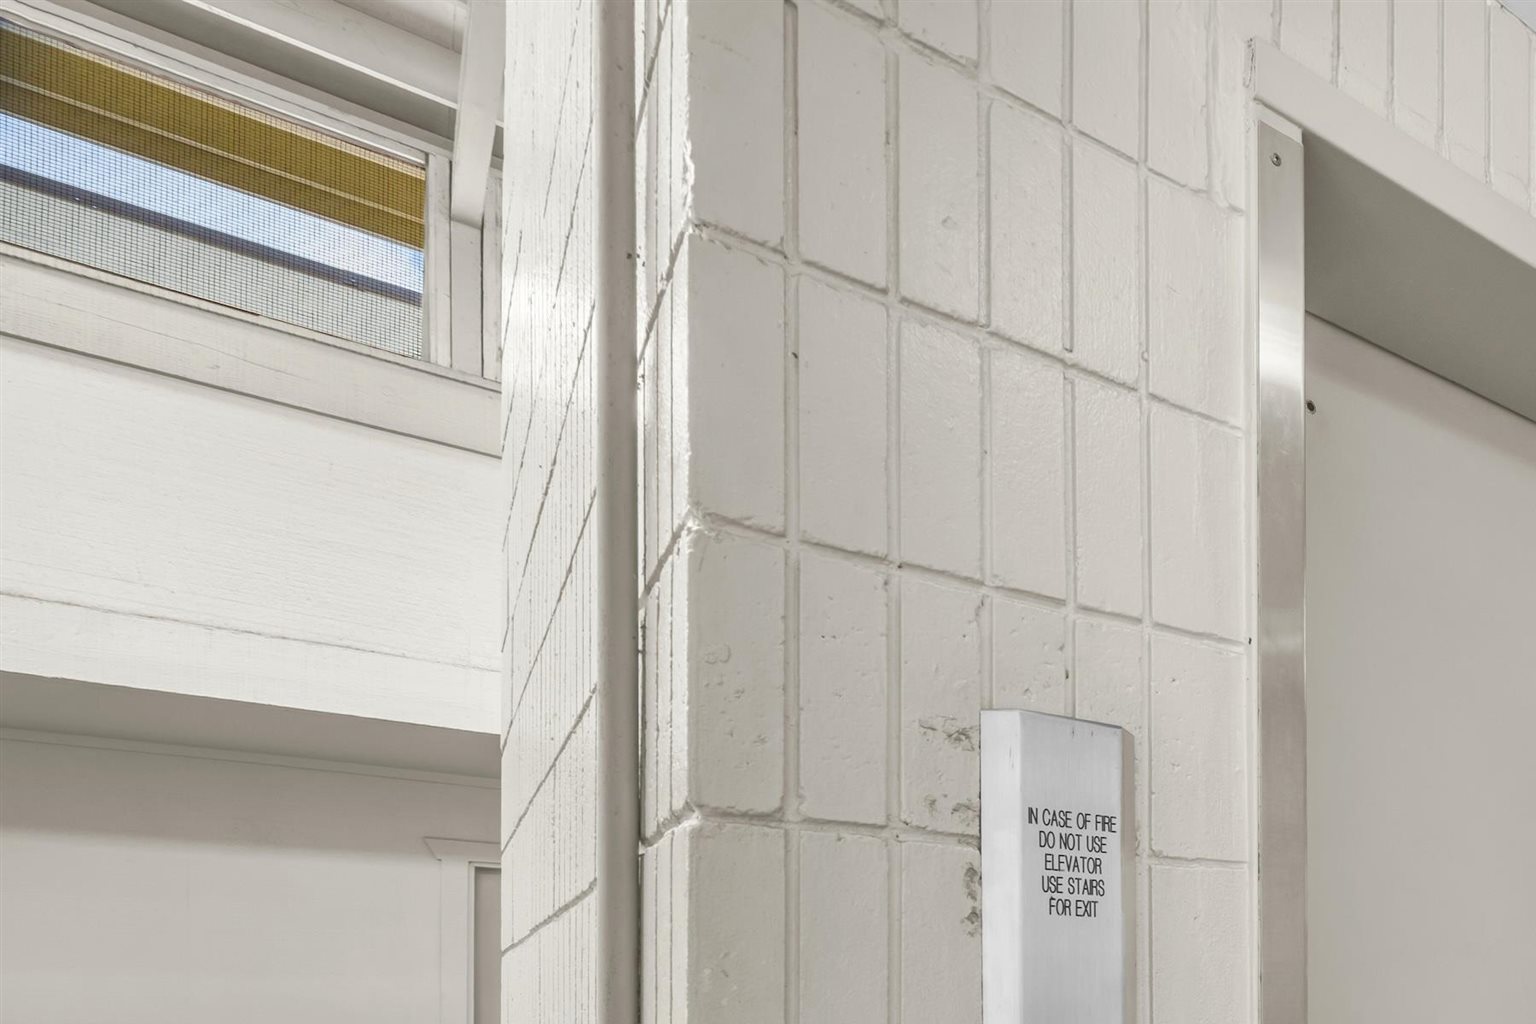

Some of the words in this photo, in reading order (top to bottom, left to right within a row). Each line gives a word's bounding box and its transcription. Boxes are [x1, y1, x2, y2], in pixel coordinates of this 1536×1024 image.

[1028, 807, 1039, 825] IN
[1042, 808, 1072, 828] CASE
[1076, 812, 1091, 830] OF
[1095, 814, 1117, 833] FIRE
[1039, 830, 1055, 849] DO
[1059, 832, 1082, 851] NOT
[1086, 835, 1107, 853] USE
[1045, 853, 1102, 875] ELEVATOR
[1042, 875, 1063, 894] USE
[1068, 877, 1105, 897] STAIRS
[1049, 896, 1071, 916] FOR
[1075, 899, 1099, 918] EXIT
